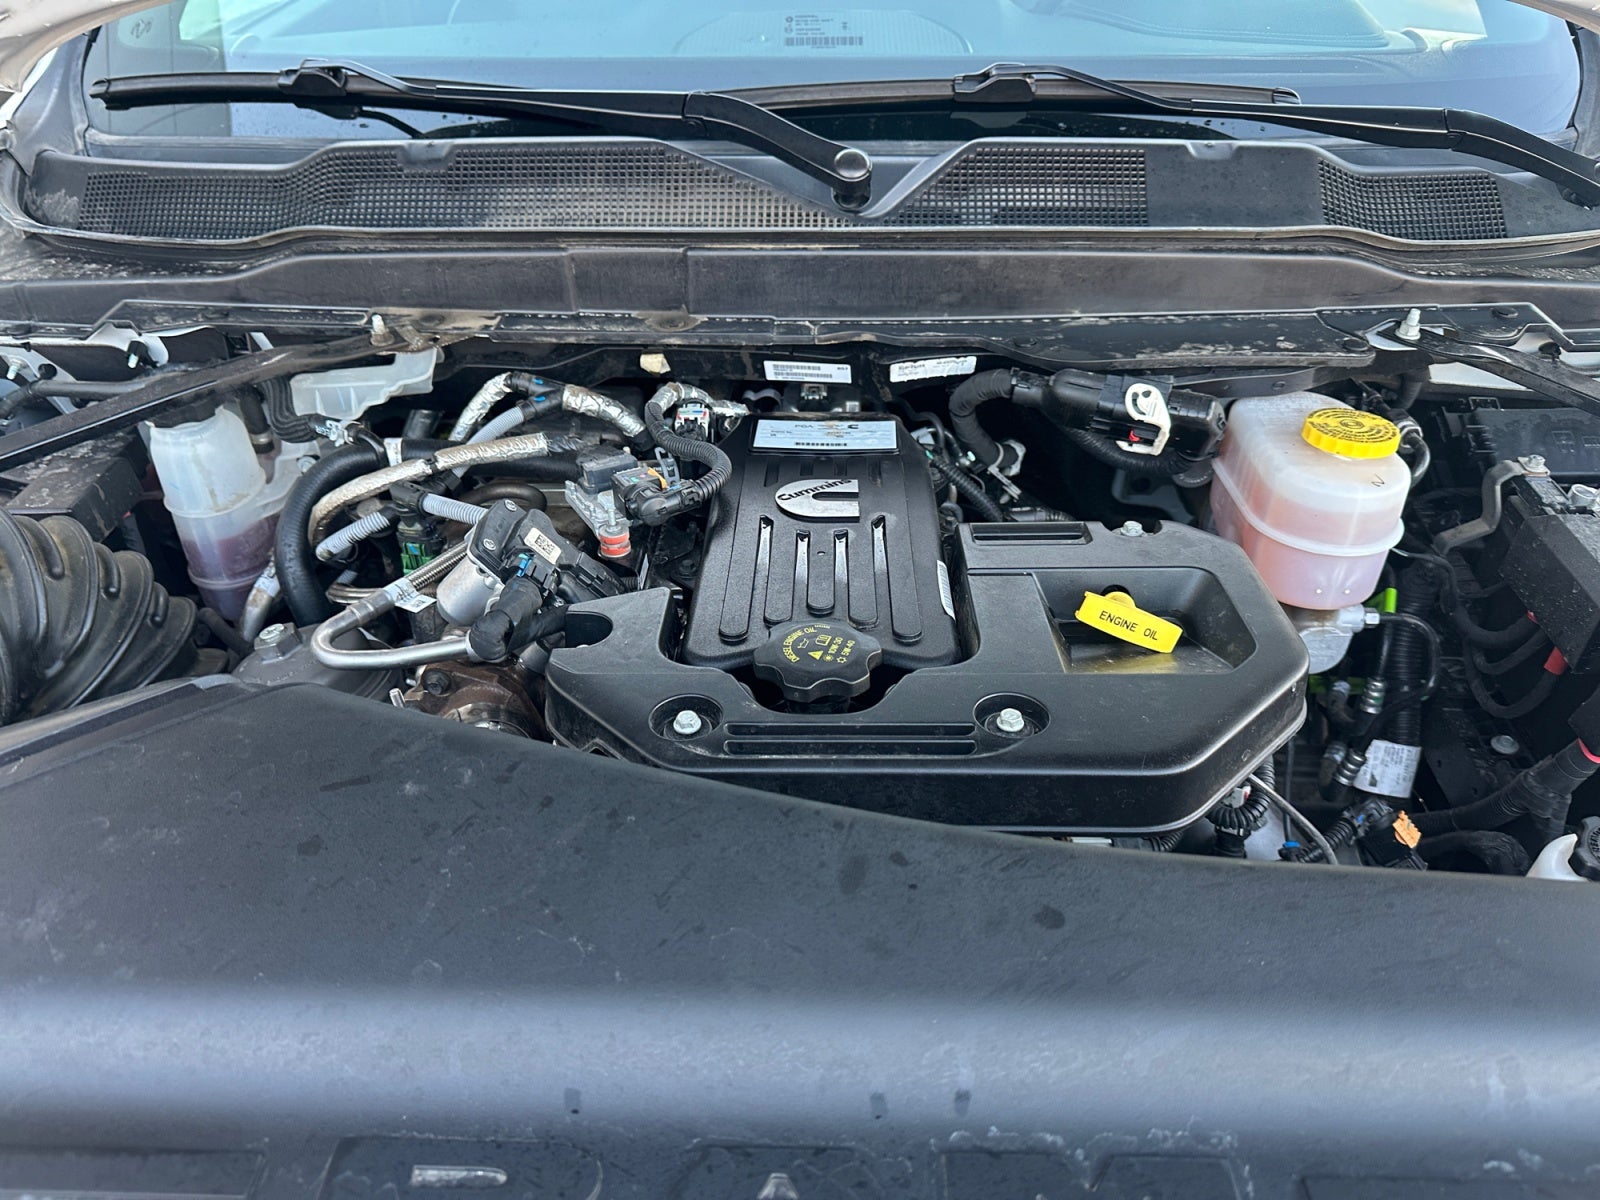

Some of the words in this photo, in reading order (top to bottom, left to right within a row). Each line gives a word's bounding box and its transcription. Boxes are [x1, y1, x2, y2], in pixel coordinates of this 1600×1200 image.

[777, 479, 852, 501] Cummins
[803, 626, 818, 634] OIL
[1098, 610, 1139, 632] ENGINE
[1143, 628, 1158, 641] OIL
[783, 629, 805, 646] ENGINE
[783, 647, 800, 663] DIESEL
